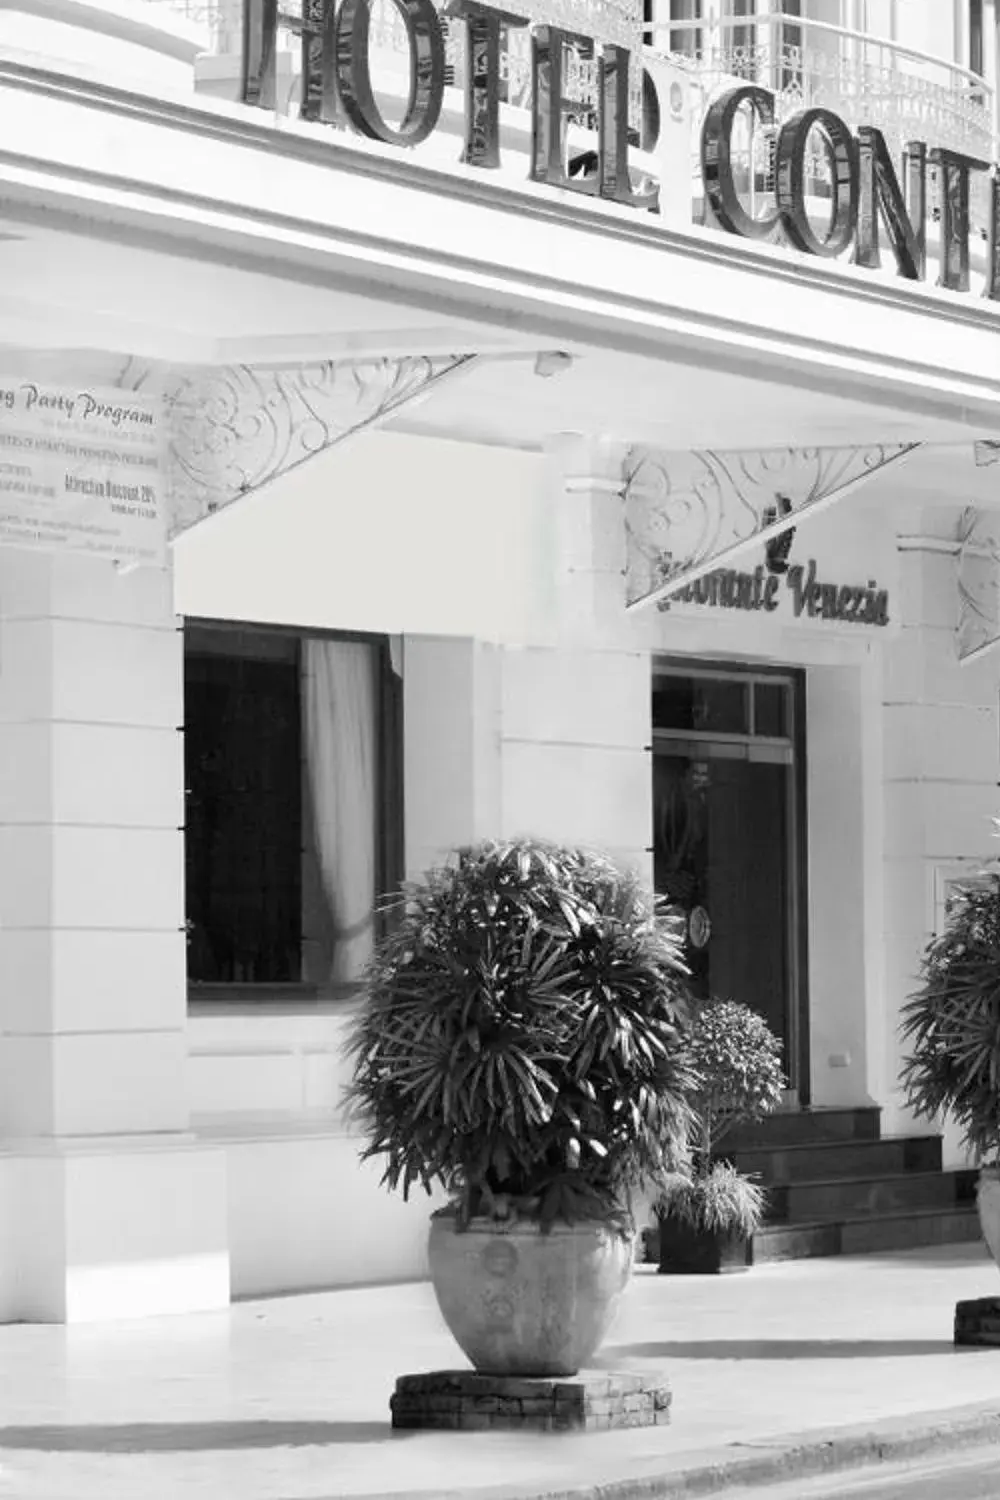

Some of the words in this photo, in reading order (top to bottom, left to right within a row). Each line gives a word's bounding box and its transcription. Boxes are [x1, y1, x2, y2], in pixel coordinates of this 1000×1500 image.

[20, 383, 75, 419] Party
[77, 393, 154, 427] Program
[786, 558, 890, 627] Venezia
